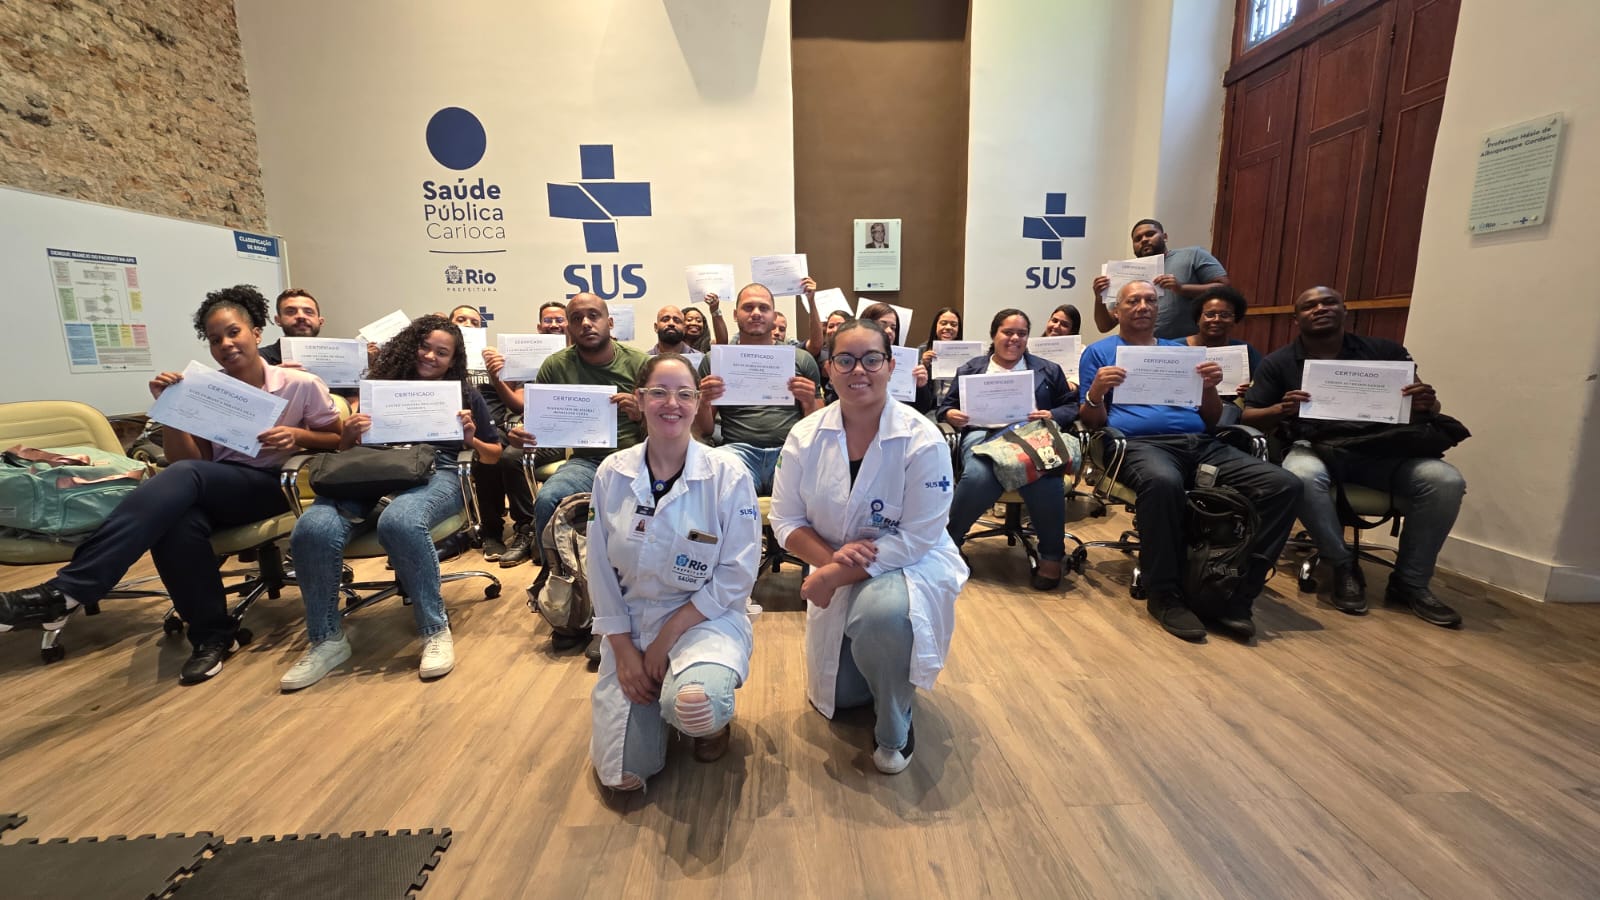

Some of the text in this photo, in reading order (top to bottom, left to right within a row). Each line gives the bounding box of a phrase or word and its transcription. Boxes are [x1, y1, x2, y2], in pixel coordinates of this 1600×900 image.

[422, 178, 501, 200] Saúde
[424, 201, 504, 221] Pública
[426, 222, 506, 240] Carioca
[465, 268, 497, 284] Rio
[563, 264, 647, 300] SUS
[1025, 266, 1076, 289] SUS
[740, 352, 775, 360] CERTIFICADO
[1334, 370, 1380, 378] CERTIFICADO
[207, 383, 249, 404] CERTIFICADO
[552, 395, 591, 403] CERTIFICADO
[739, 508, 753, 516] SUS
[688, 559, 708, 572] Rio
